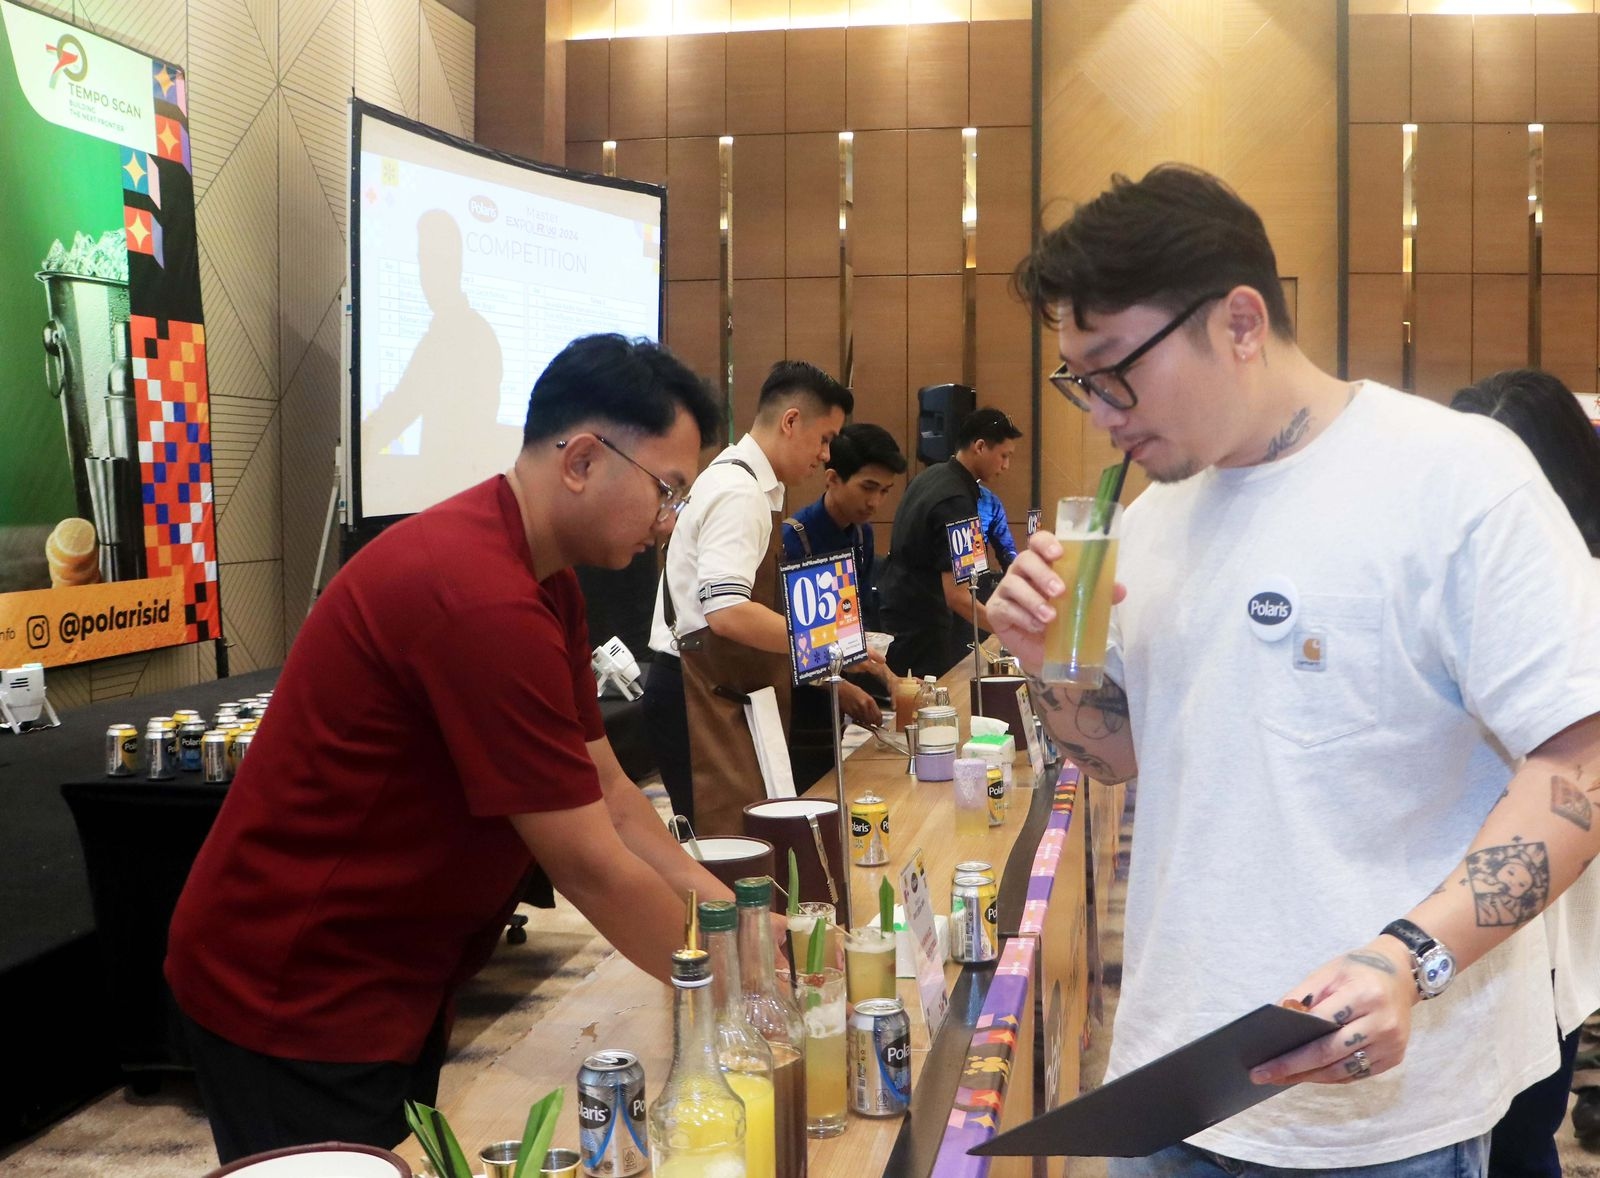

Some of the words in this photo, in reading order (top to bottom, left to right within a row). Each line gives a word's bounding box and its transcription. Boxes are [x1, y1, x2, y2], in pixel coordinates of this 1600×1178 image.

[68, 82, 109, 108] TEMPO
[112, 99, 141, 119] SCAN
[466, 231, 588, 274] COMPETITION
[951, 526, 974, 556] 04
[793, 571, 837, 626] 05
[1250, 600, 1290, 618] Polaris
[59, 599, 170, 643] @polarisid
[579, 1100, 608, 1122] laris
